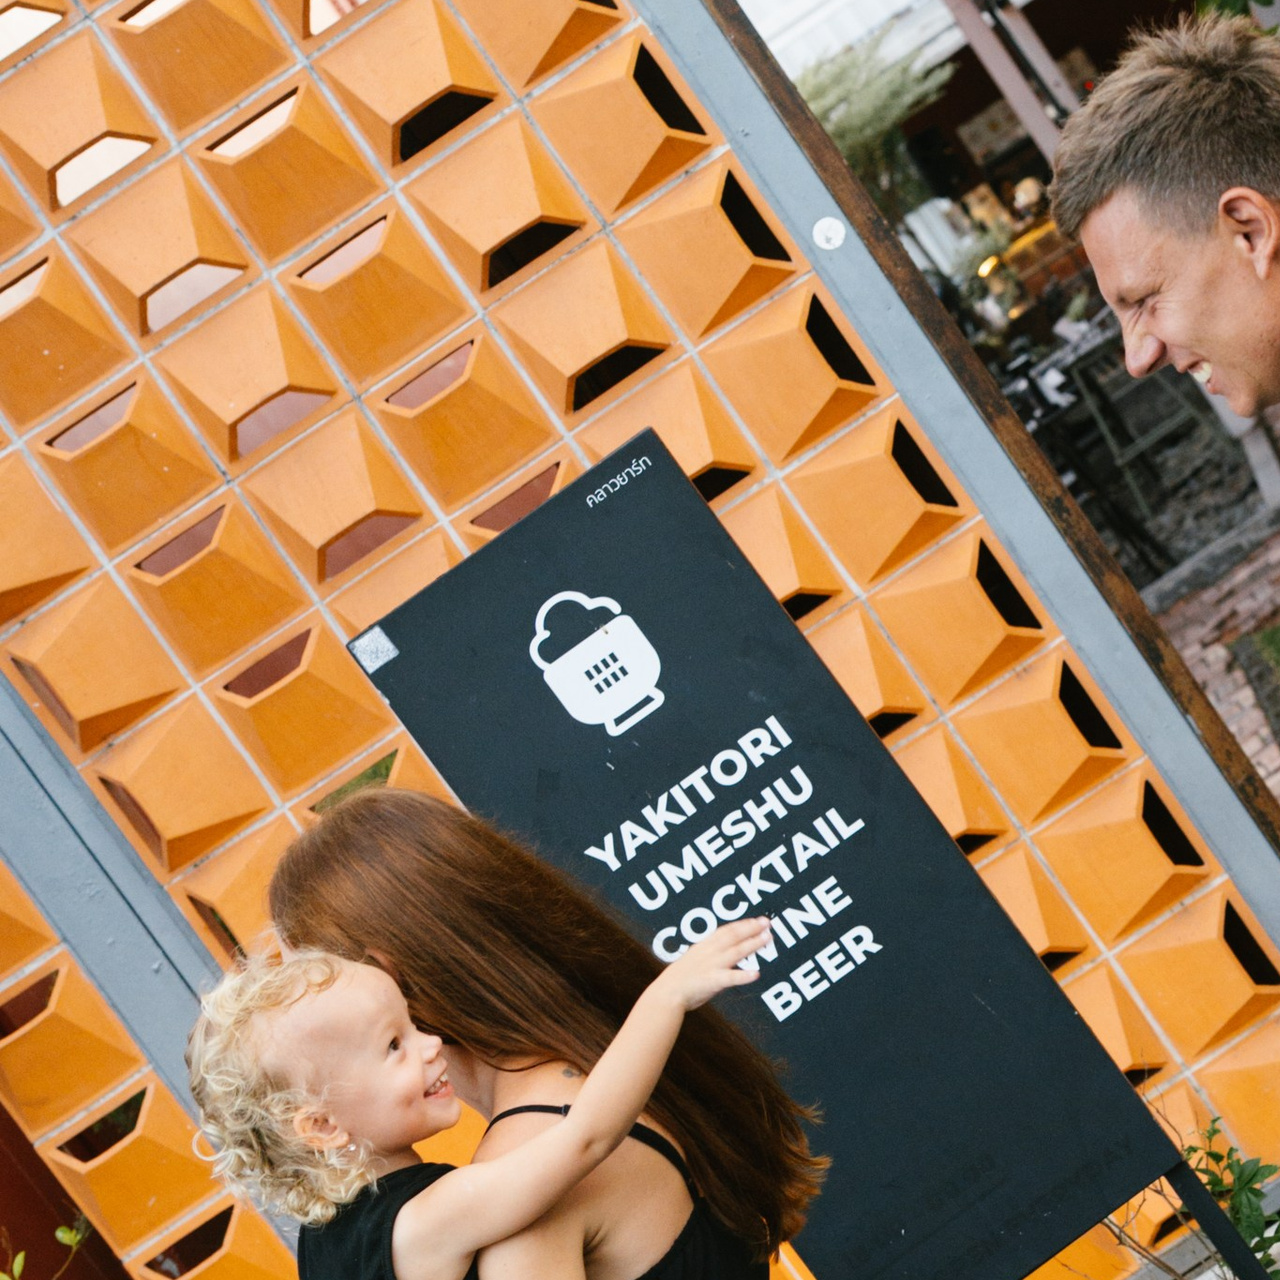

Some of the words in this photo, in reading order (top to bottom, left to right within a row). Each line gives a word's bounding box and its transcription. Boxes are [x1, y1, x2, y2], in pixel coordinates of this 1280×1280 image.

[583, 714, 793, 872] YAKITORI
[627, 765, 814, 911] UMESHU
[651, 807, 866, 963] COCKTAIL
[760, 924, 884, 1023] BEER
